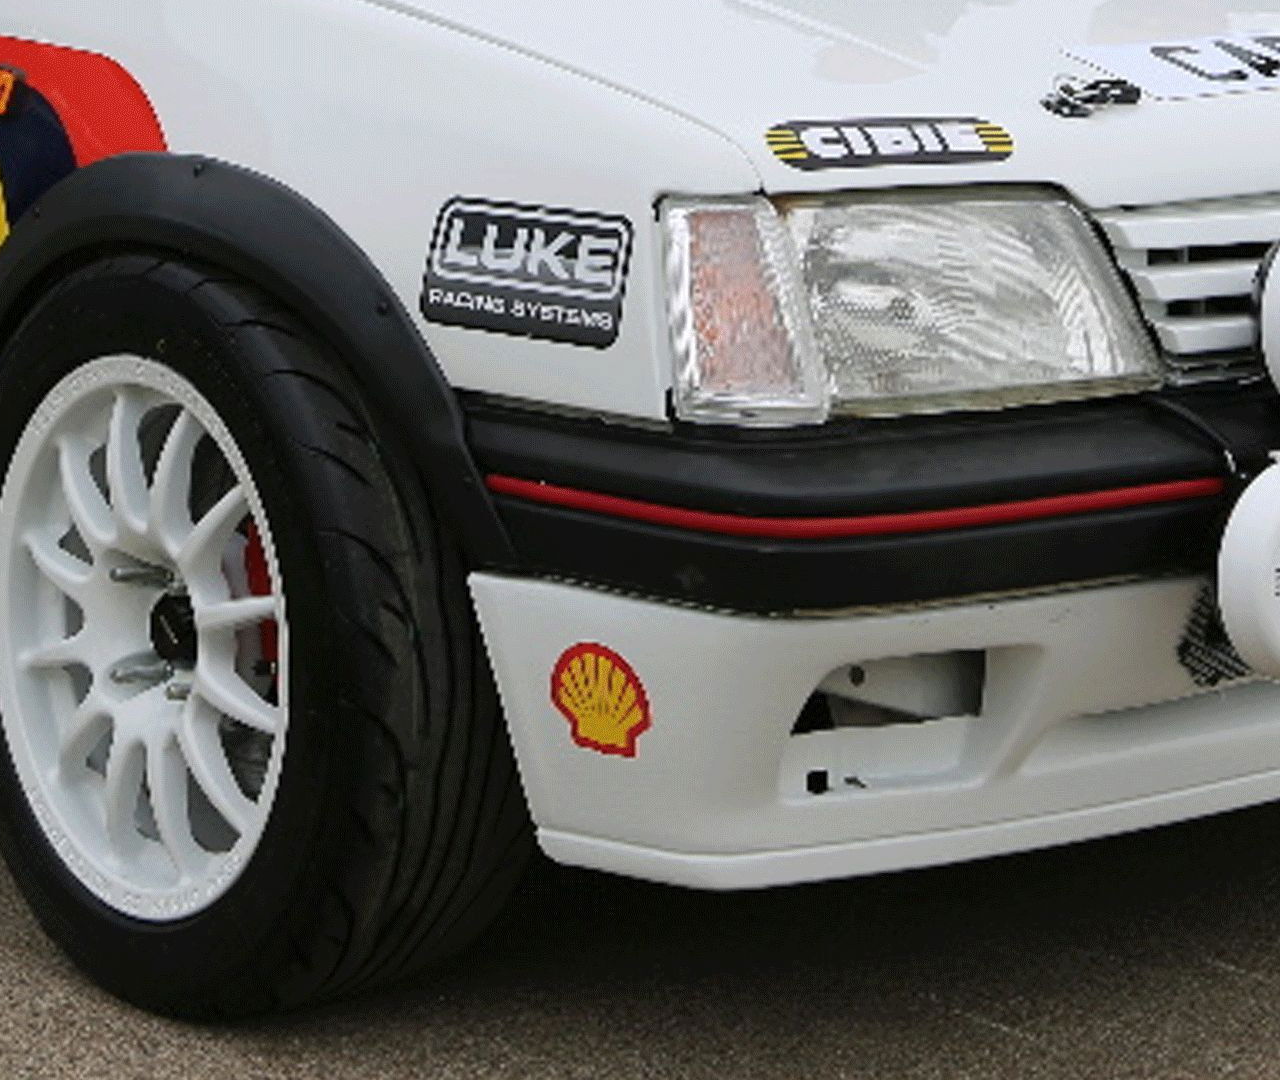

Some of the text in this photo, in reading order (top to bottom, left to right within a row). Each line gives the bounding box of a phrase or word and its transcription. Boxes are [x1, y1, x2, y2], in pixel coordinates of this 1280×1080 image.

[441, 218, 621, 287] LUKE
[428, 288, 614, 331] RACING SYSTEMS
